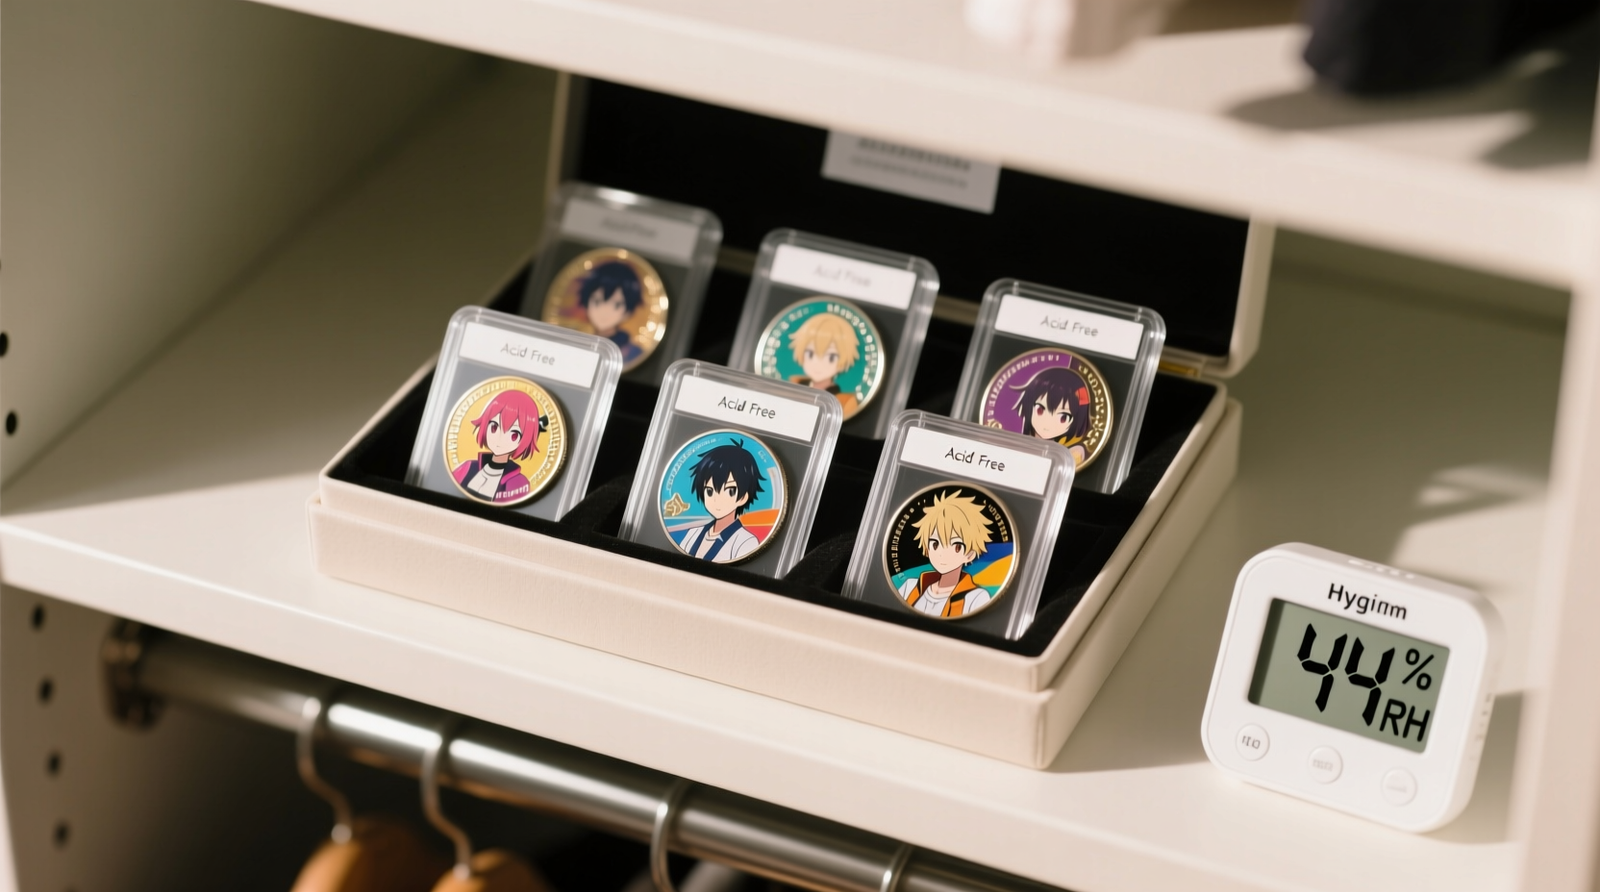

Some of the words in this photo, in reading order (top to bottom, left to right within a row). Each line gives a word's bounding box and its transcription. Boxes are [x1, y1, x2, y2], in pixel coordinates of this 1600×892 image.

[1041, 316, 1068, 330] Acid
[1072, 323, 1098, 337] Free
[500, 343, 528, 358] Acid
[531, 350, 556, 365] Free
[718, 397, 746, 412] Acid
[749, 404, 776, 419] Free
[945, 447, 975, 464] Acid
[978, 455, 1005, 472] Free
[1297, 623, 1396, 726] 44
[1379, 698, 1431, 742] RH
